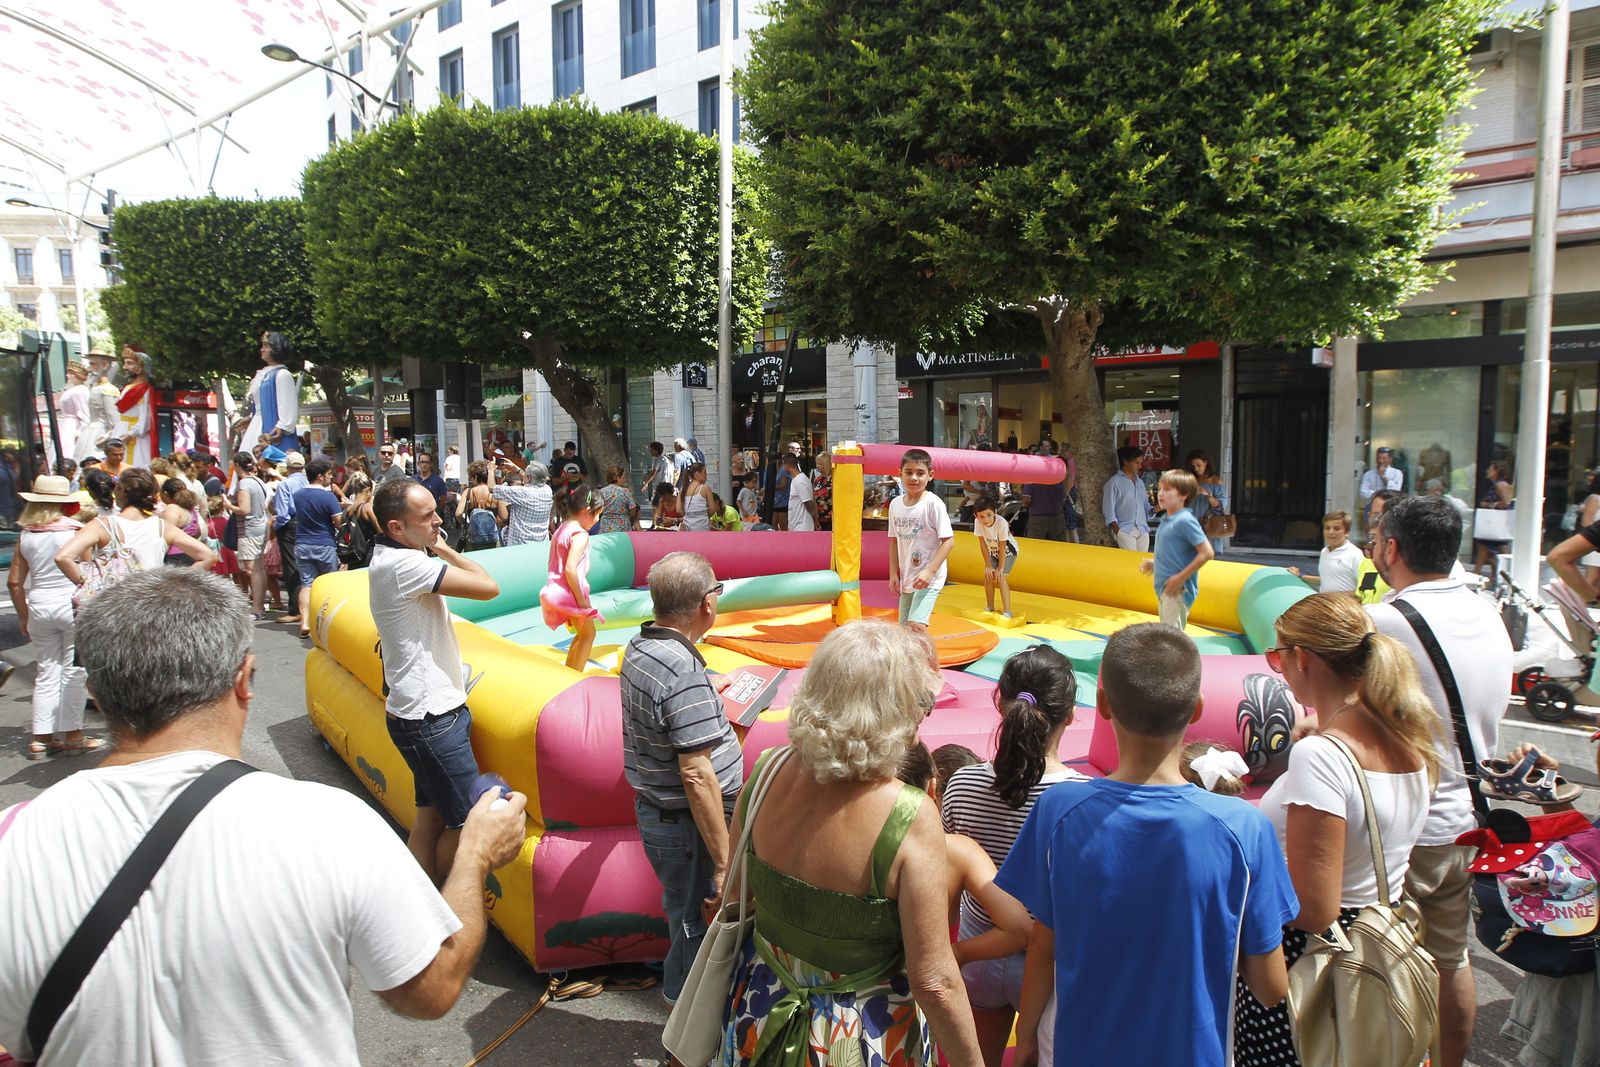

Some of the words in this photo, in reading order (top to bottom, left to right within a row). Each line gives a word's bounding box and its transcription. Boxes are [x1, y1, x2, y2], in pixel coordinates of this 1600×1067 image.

[938, 350, 1016, 365] MARTINELLI
[747, 356, 793, 377] Charan
[1138, 431, 1162, 447] BA
[1140, 446, 1164, 460] AS
